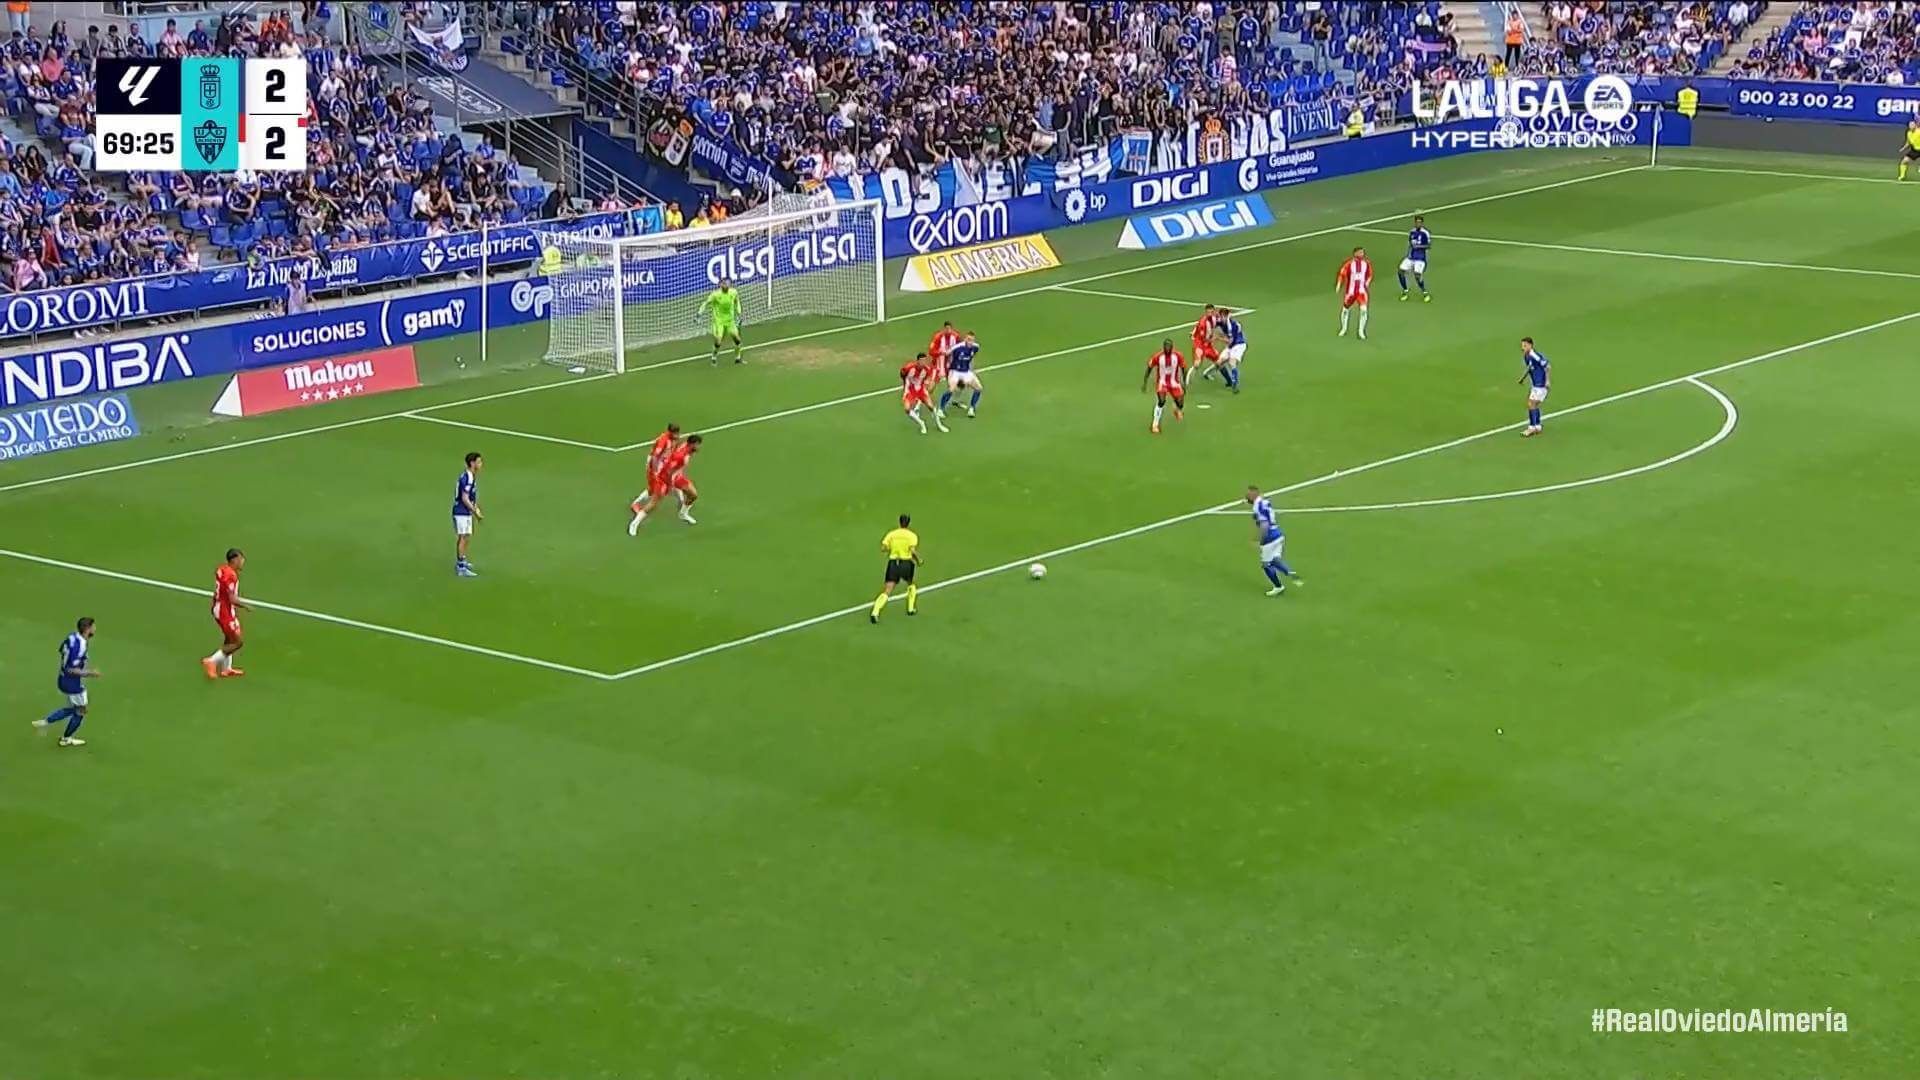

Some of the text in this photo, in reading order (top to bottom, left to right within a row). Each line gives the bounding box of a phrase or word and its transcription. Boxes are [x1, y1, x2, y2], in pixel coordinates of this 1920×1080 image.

[1739, 90, 1854, 109] 900 23 00 22
[1090, 191, 1107, 211] bp
[1132, 170, 1209, 208] DIGI
[909, 201, 1008, 250] exiom
[1150, 200, 1257, 243] DIGI
[707, 232, 856, 285] alsa alsa
[930, 240, 1047, 286] ALIMERKA
[560, 270, 655, 298] GRUPO PAHUCA
[0, 281, 149, 335] OROMI
[253, 320, 366, 352] SOLUCIONES
[284, 360, 375, 390] Mahou
